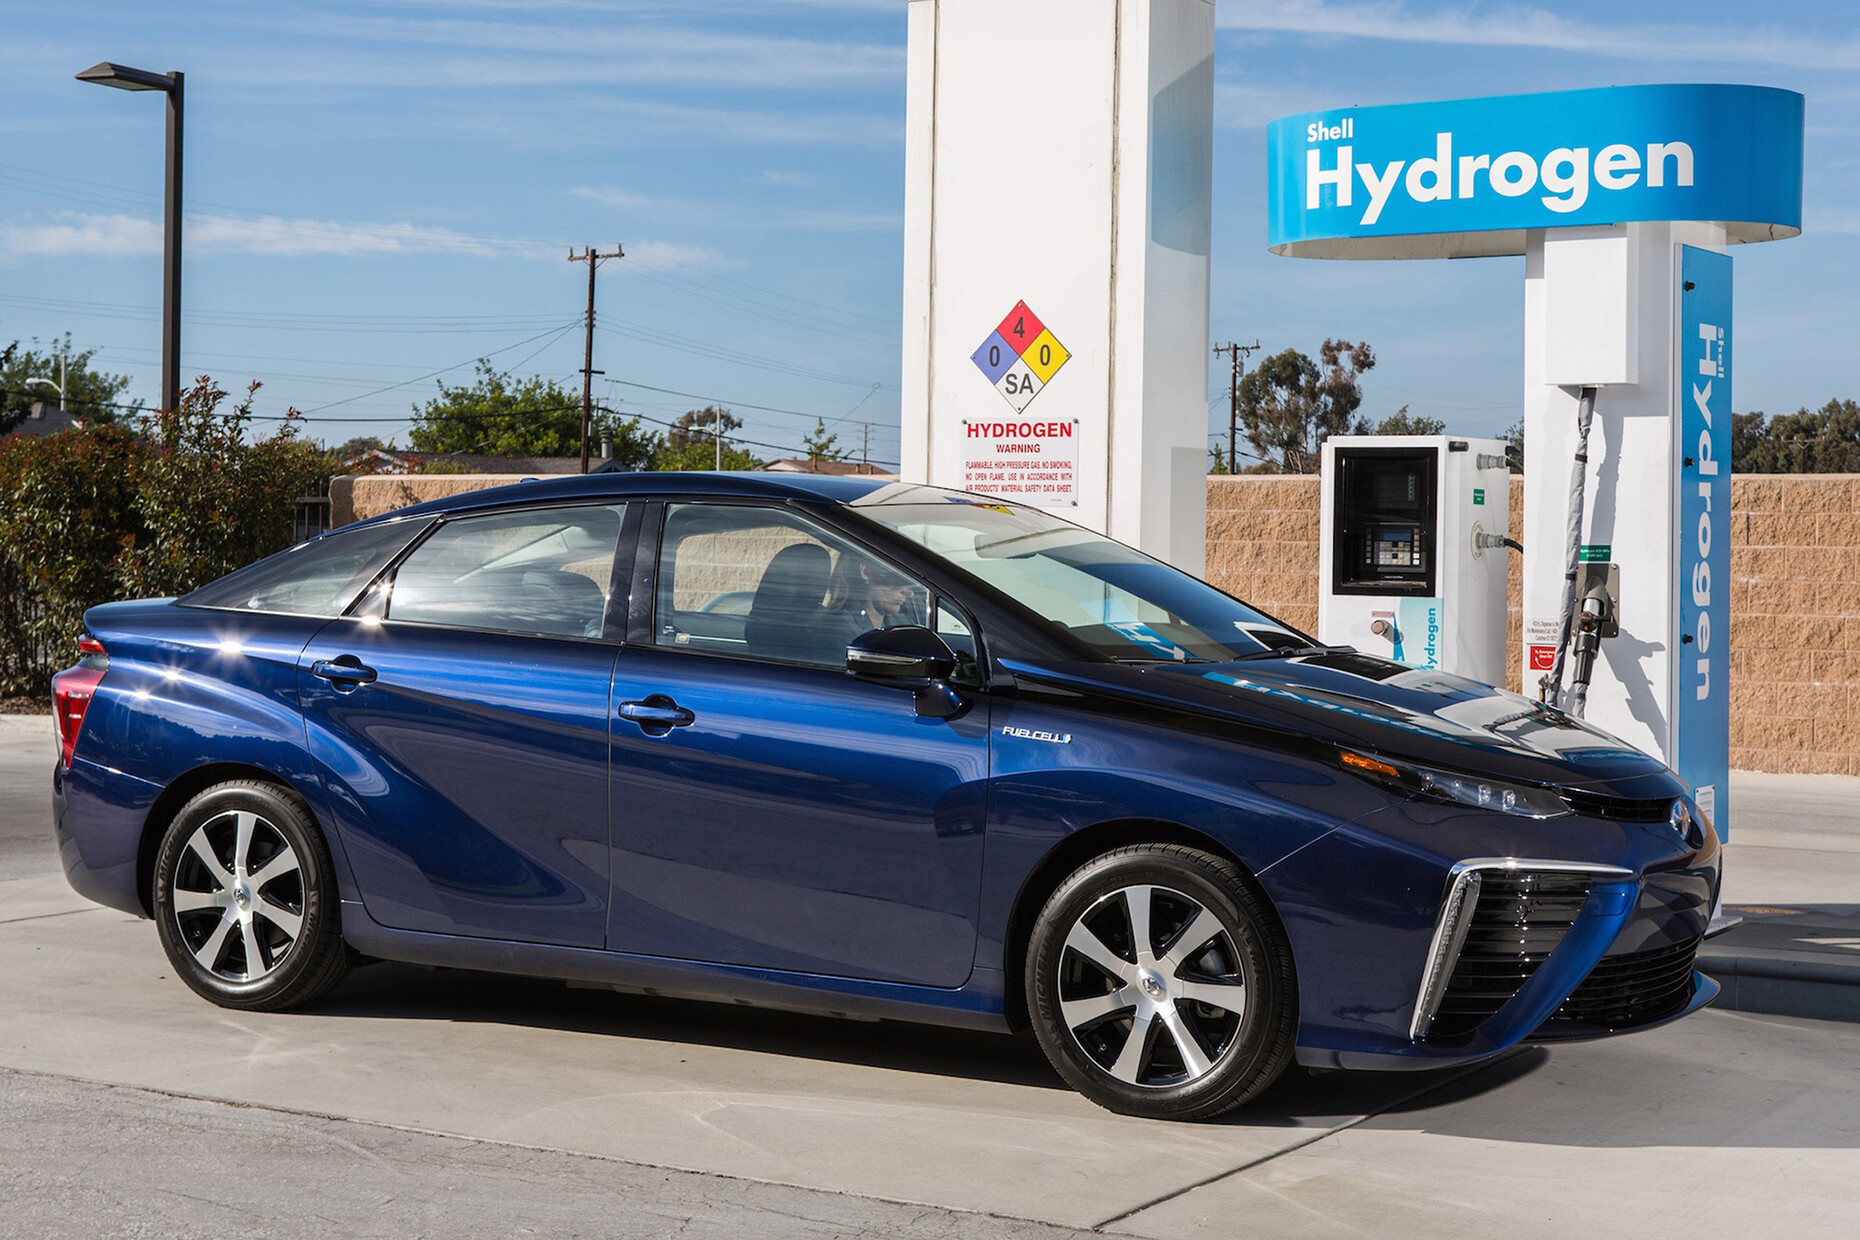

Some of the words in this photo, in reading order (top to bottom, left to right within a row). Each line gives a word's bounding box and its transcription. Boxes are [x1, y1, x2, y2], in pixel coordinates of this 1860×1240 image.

[1307, 118, 1353, 142] Shell
[1306, 133, 1694, 226] Hydrogen
[1013, 317, 1025, 338] 4
[989, 345, 1000, 367] 0
[1040, 344, 1051, 366] 0
[1717, 327, 1725, 378] Shell
[1005, 373, 1034, 394] SA
[967, 422, 1072, 438] HYDROGEN
[996, 444, 1041, 453] WARNING
[994, 460, 1006, 470] HIGH
[1006, 460, 1030, 470] PRESSURE
[1042, 460, 1050, 470] NO
[965, 472, 973, 481] NO
[974, 472, 988, 481] OPEN
[1008, 472, 1018, 481] USE
[1019, 472, 1026, 481] IN
[1027, 472, 1059, 481] ACCORDANCE
[1060, 472, 1073, 481] WITH
[965, 484, 973, 492] AIR
[1000, 484, 1023, 493] MATERIAL
[1024, 484, 1042, 493] SAFETY
[1043, 484, 1056, 493] DATA
[1692, 323, 1718, 701] Hydrogen
